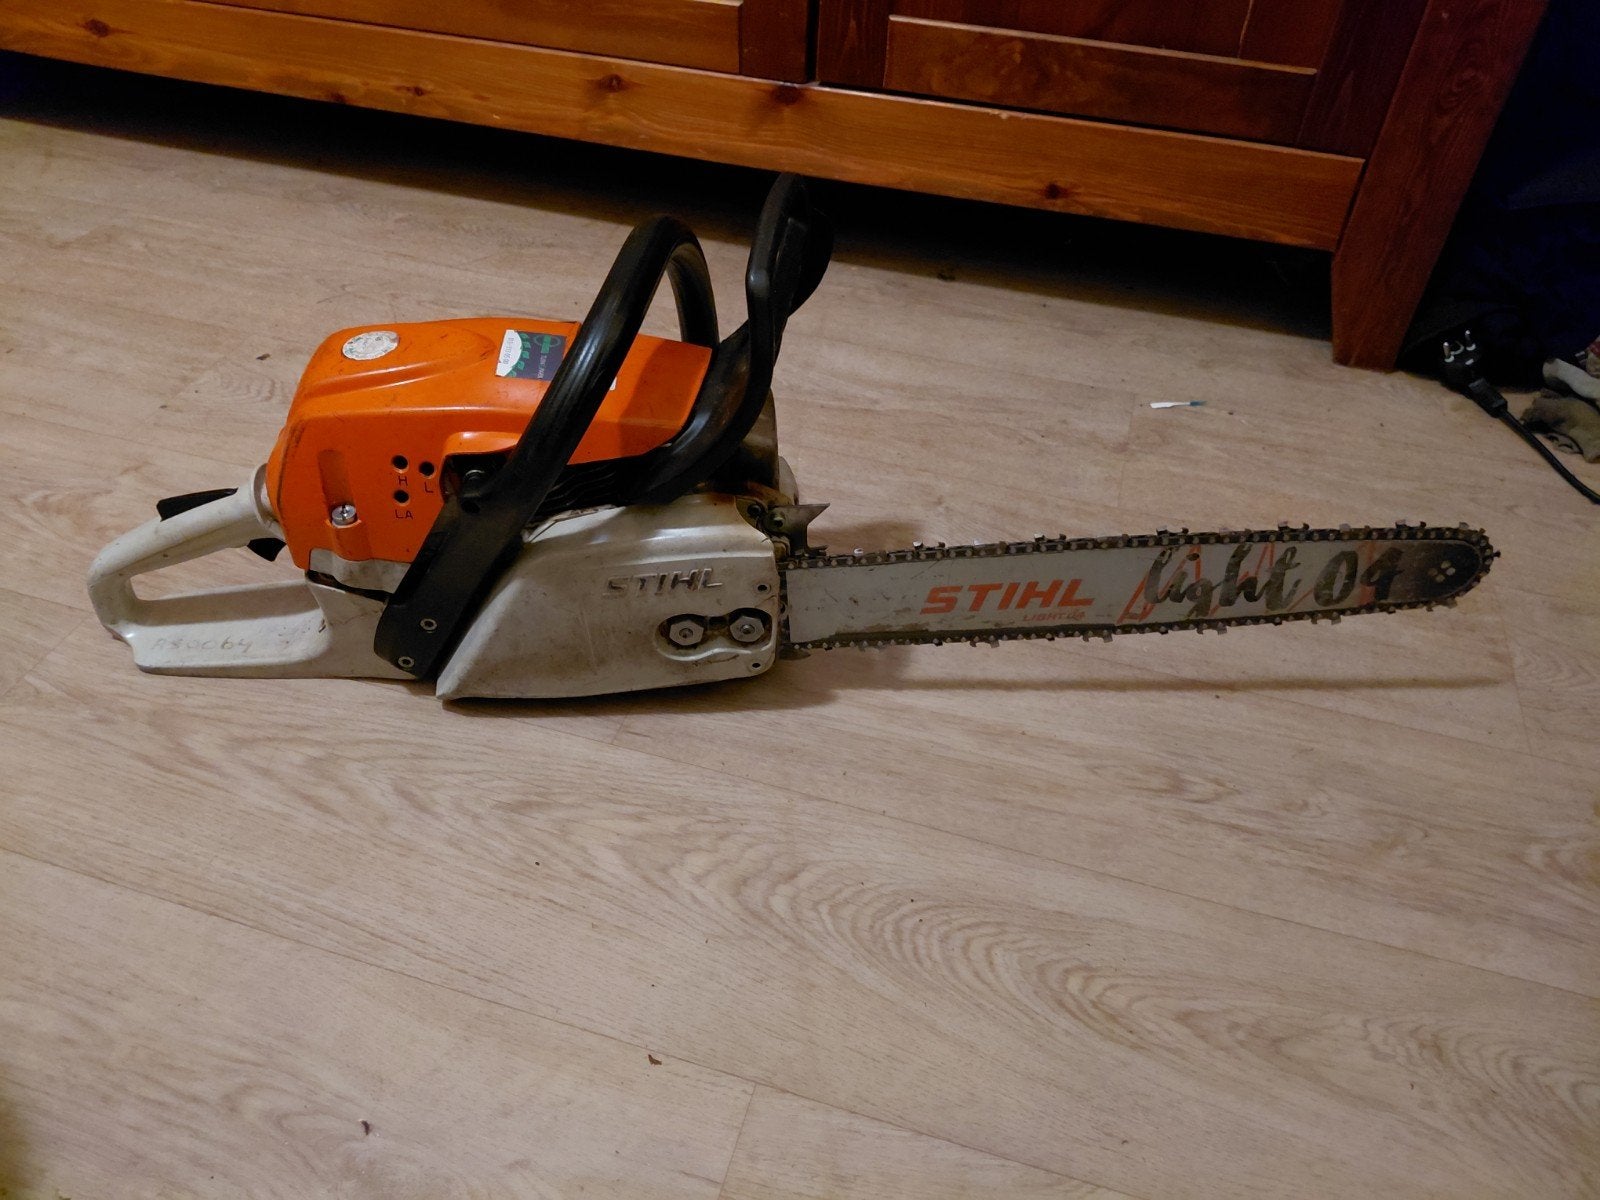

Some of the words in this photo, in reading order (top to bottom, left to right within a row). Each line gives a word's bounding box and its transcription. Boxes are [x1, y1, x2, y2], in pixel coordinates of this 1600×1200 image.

[397, 475, 409, 487] H
[424, 481, 435, 494] L
[394, 508, 414, 520] LA
[602, 567, 723, 596] STIHL
[1144, 542, 1301, 619] light
[919, 577, 1095, 614] STIHL
